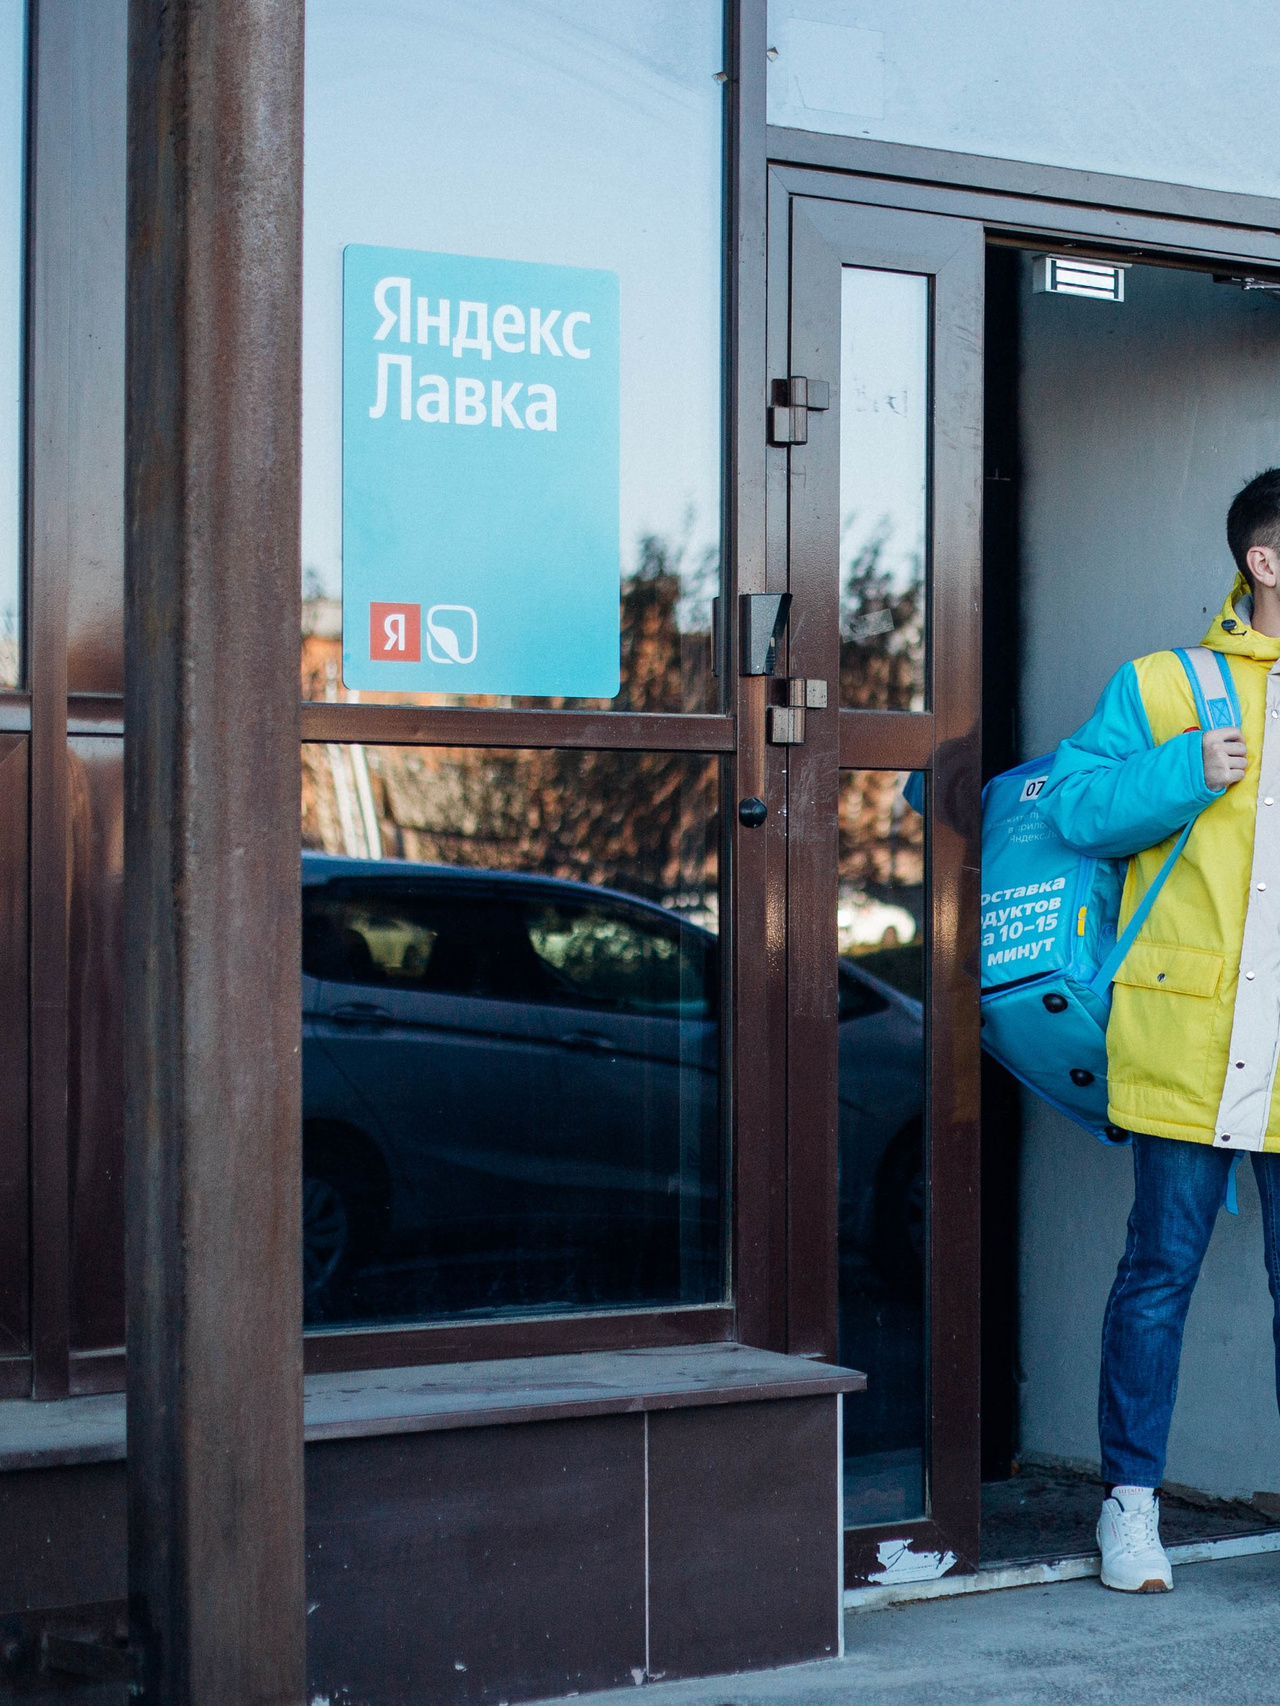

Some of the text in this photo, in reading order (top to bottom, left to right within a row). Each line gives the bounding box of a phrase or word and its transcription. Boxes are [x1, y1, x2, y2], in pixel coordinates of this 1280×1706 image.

[373, 276, 591, 361] Яндекс
[369, 353, 558, 433] Лавка
[383, 613, 406, 652] Я
[1026, 781, 1046, 797] 07
[1010, 830, 1058, 843] Яндекс.Л
[981, 897, 1062, 930] дуктов
[981, 932, 995, 947] а
[987, 937, 1056, 967] минут
